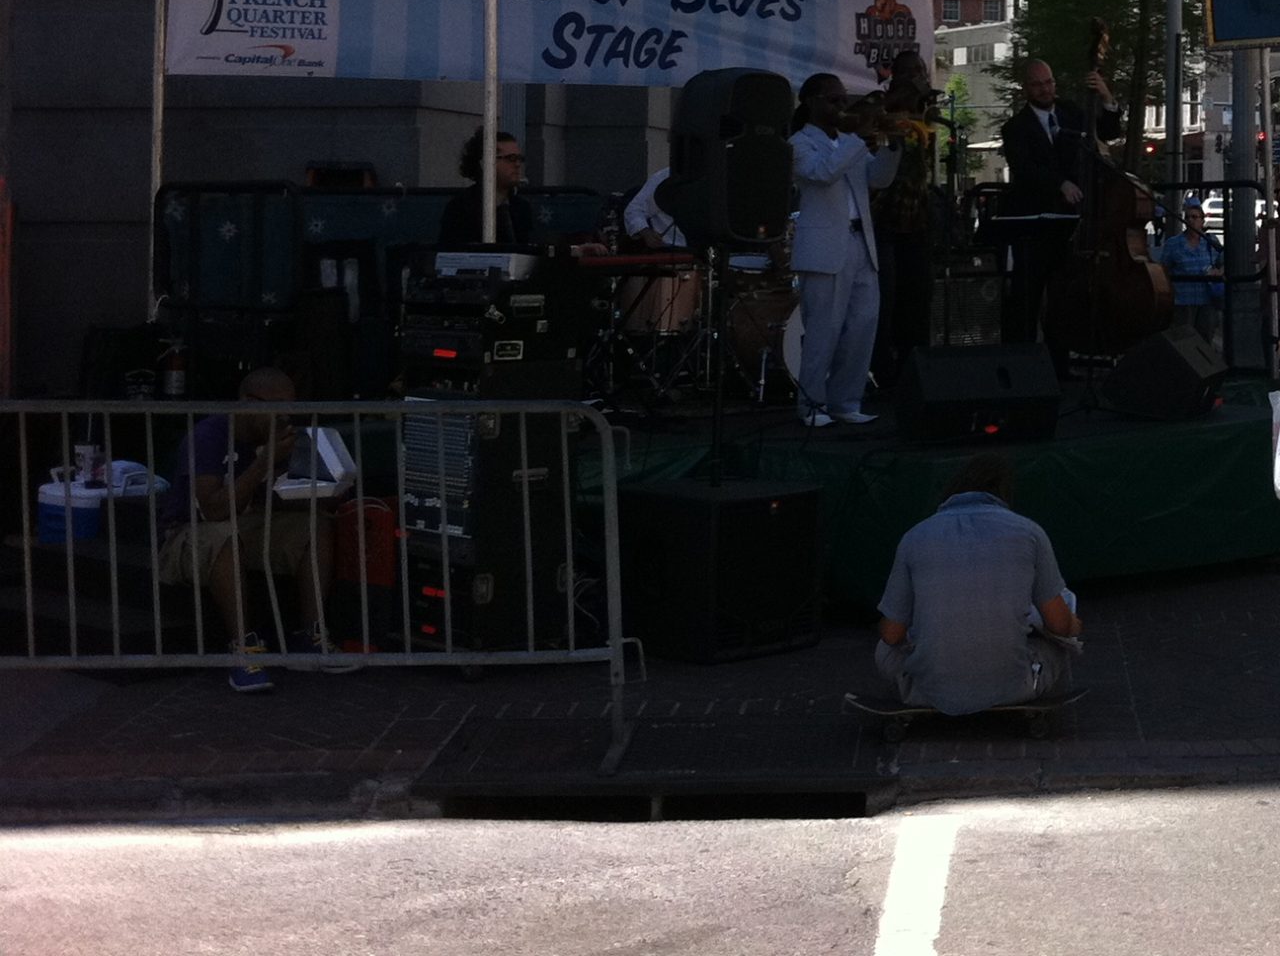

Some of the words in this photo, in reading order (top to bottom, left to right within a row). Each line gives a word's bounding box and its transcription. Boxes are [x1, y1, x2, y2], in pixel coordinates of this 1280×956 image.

[227, 7, 328, 27] QUARTER
[249, 26, 328, 40] FESTIVAL
[860, 18, 915, 37] HOUSE
[542, 11, 689, 70] STAGE
[297, 58, 326, 68] Bank
